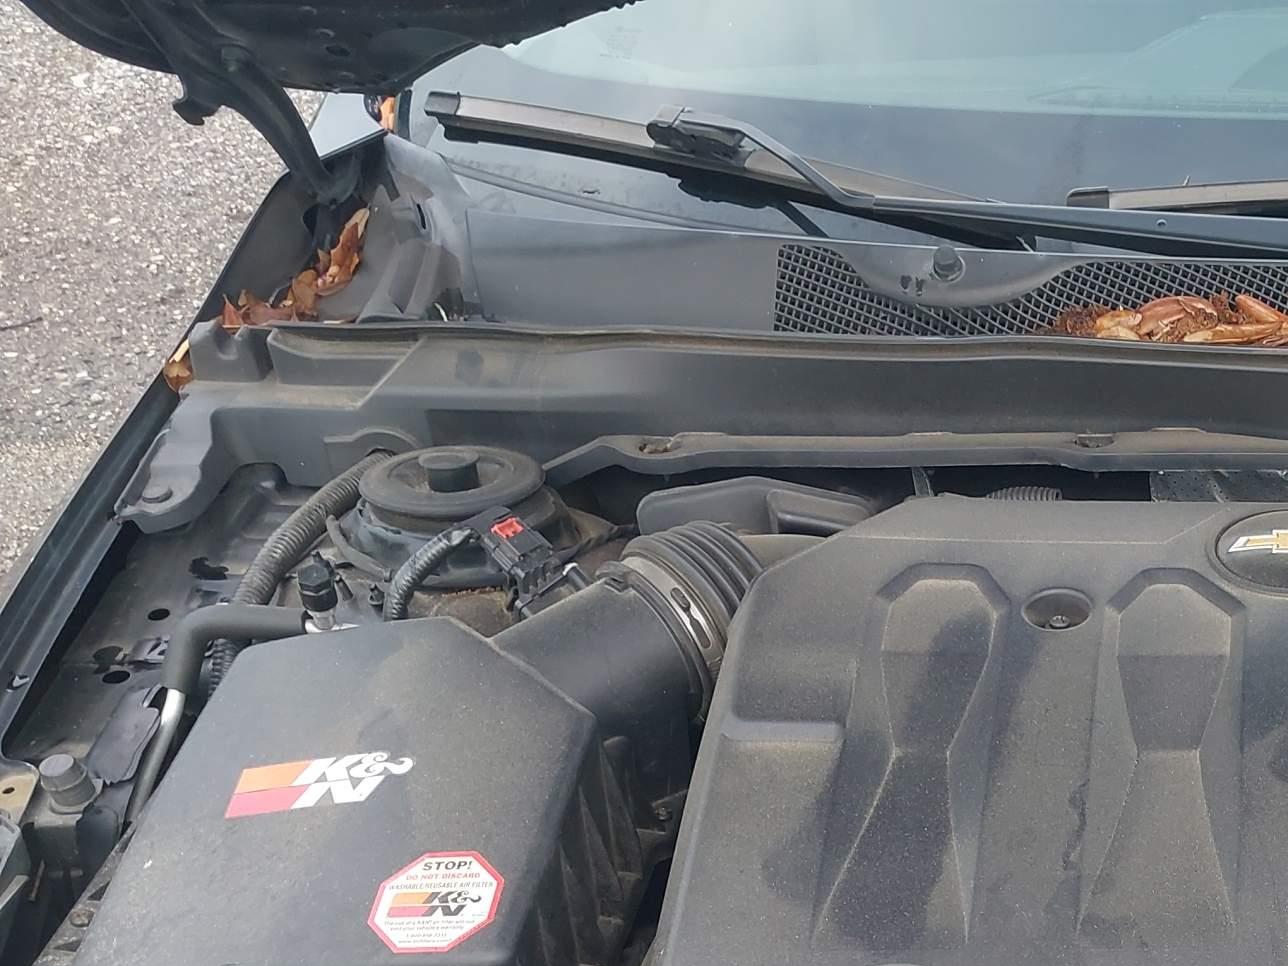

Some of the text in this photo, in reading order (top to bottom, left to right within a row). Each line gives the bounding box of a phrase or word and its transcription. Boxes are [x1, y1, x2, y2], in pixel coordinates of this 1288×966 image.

[422, 860, 473, 871] STOP!
[420, 873, 439, 881] NOT
[441, 872, 481, 880] DISCARD
